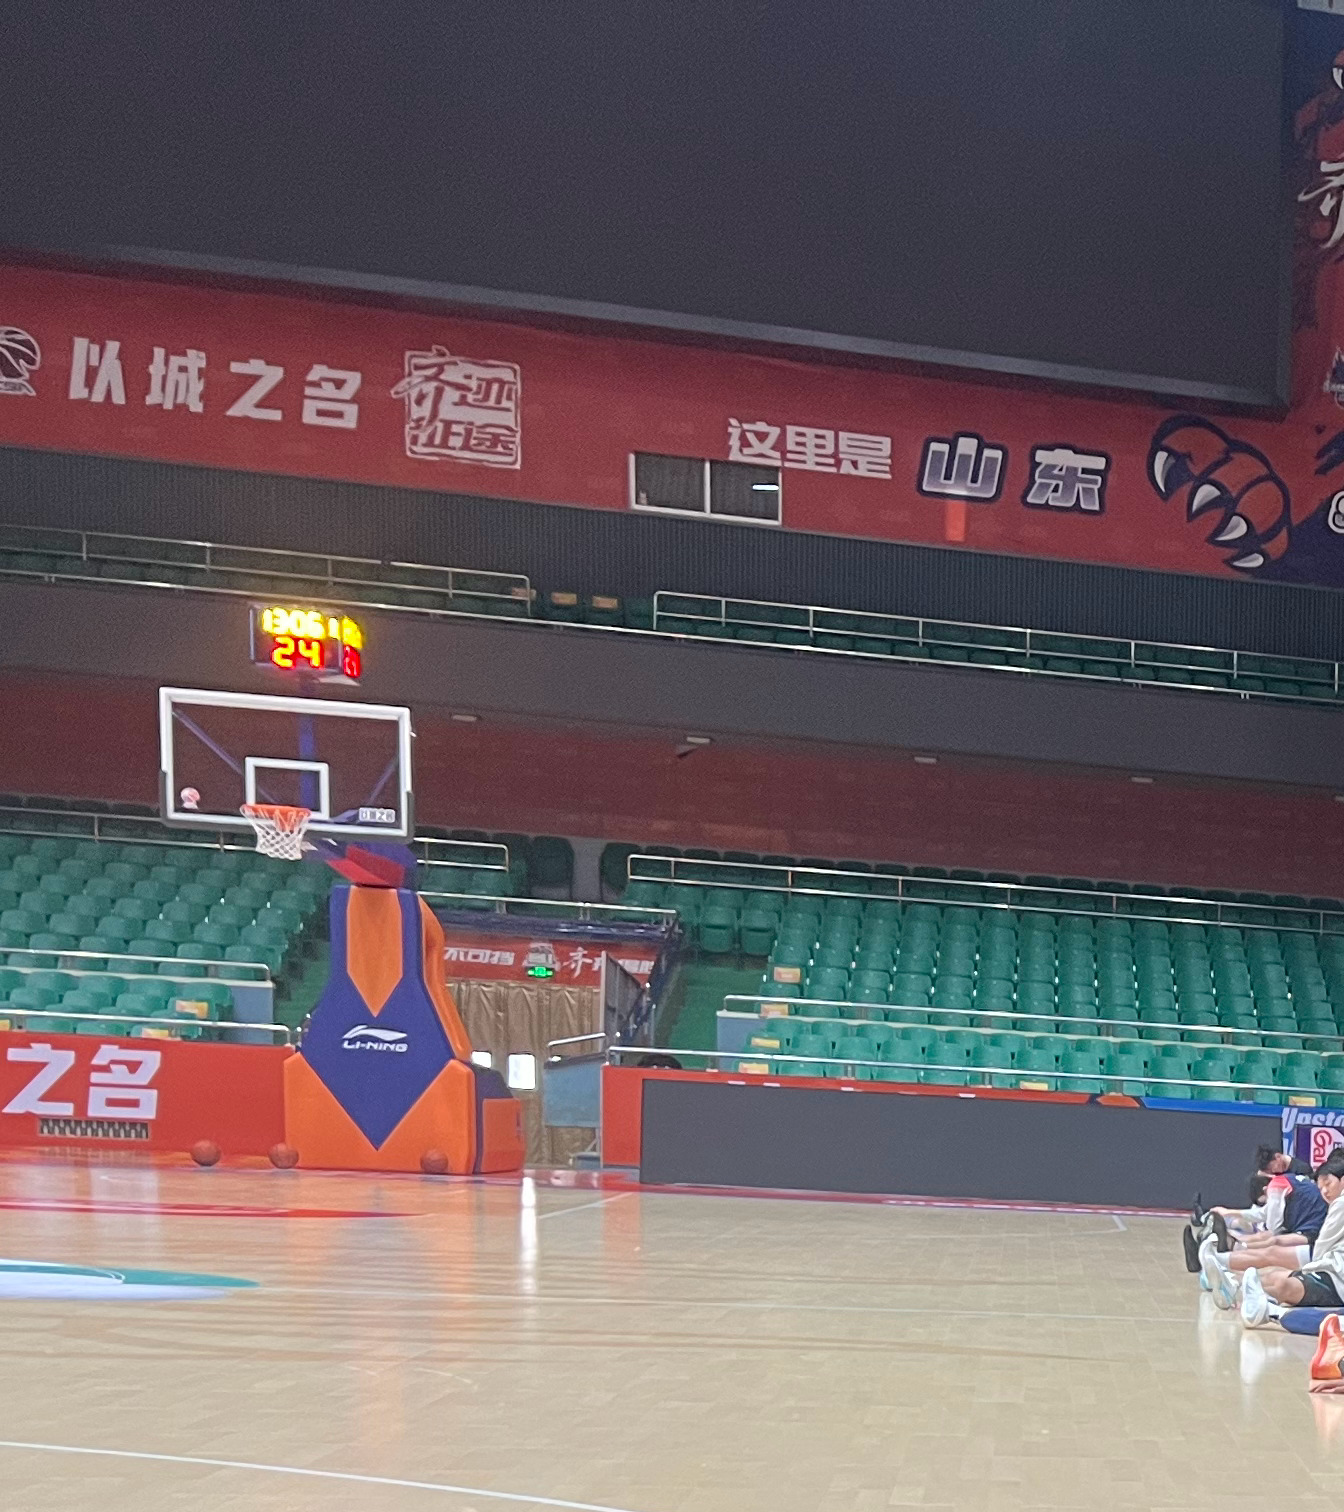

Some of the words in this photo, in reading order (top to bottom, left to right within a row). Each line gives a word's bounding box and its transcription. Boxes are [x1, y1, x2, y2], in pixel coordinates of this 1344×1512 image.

[69, 336, 362, 429] 以城之名
[727, 417, 892, 480] 这里是
[922, 436, 1106, 511] 山东
[271, 635, 321, 669] 24
[2, 1043, 161, 1120] 之名
[343, 1040, 408, 1053] LI-NING
